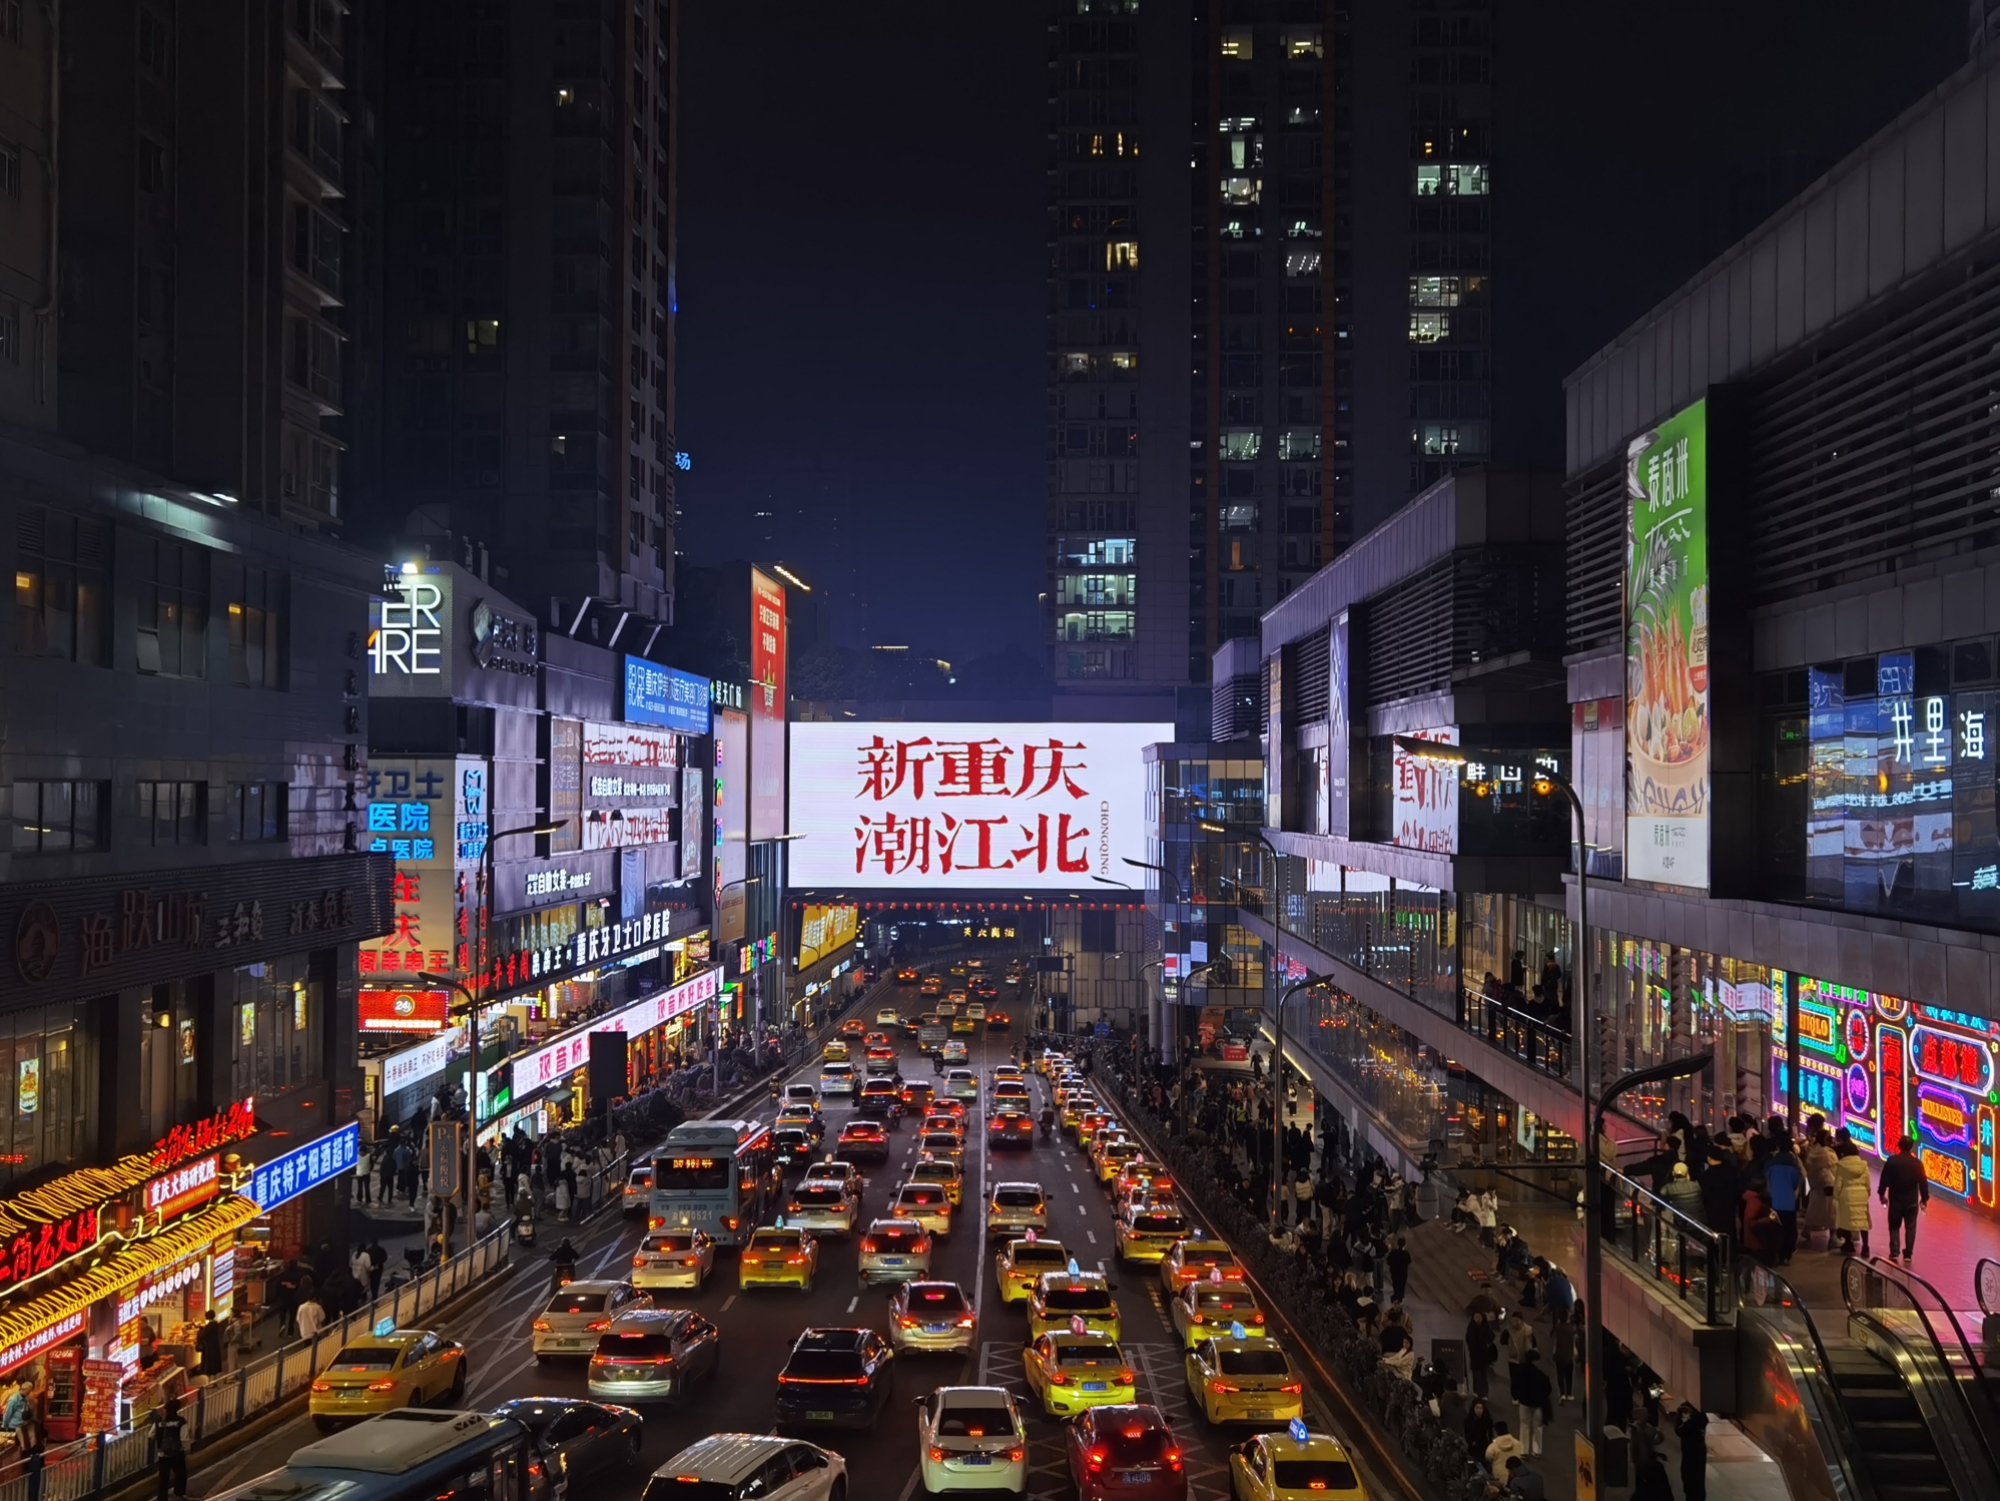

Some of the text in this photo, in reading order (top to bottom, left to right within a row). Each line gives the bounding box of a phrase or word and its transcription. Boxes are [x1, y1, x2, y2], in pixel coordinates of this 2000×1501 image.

[675, 452, 690, 470] 场
[854, 735, 1090, 800] 新重庆
[369, 802, 430, 832] 医院
[854, 811, 1090, 875] 潮江北
[1100, 800, 1110, 875] CHONGQING
[576, 908, 671, 967] 重庆牙卫士口腔医院
[657, 976, 713, 1021] 观音桥好吃街
[438, 1128, 447, 1139] P
[151, 1157, 217, 1207] 重庆火锅研究院
[256, 1131, 354, 1206] 重庆特产烟酒超市
